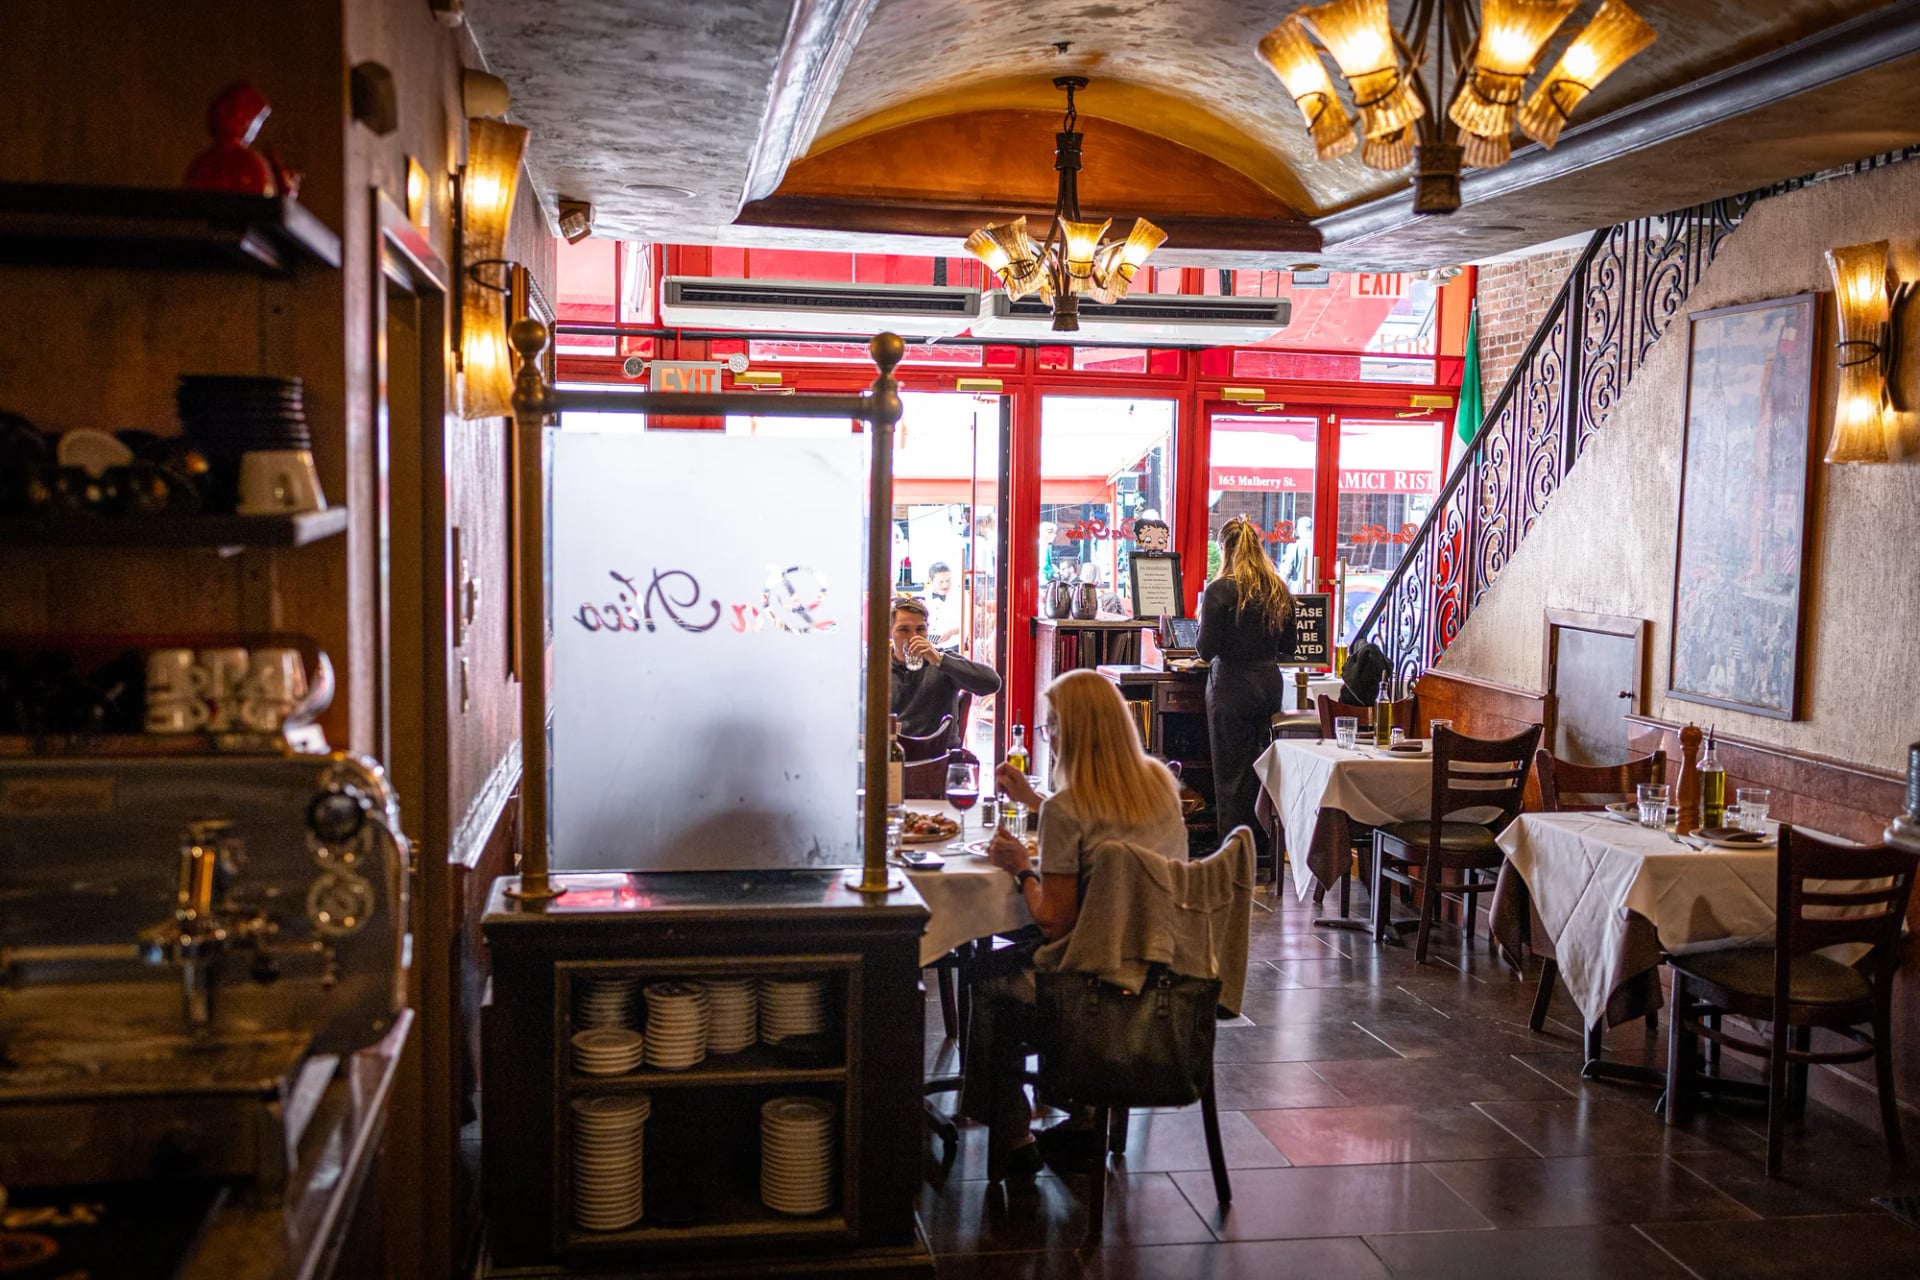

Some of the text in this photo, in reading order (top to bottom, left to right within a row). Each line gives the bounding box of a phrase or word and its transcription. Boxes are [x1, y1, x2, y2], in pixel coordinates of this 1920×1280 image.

[660, 367, 716, 394] EXIT
[1218, 475, 1296, 489] 165 Mulberry St.
[1294, 607, 1323, 618] EASE
[1296, 620, 1316, 630] AIT
[1302, 632, 1318, 642] BE
[1294, 644, 1324, 655] ATED
